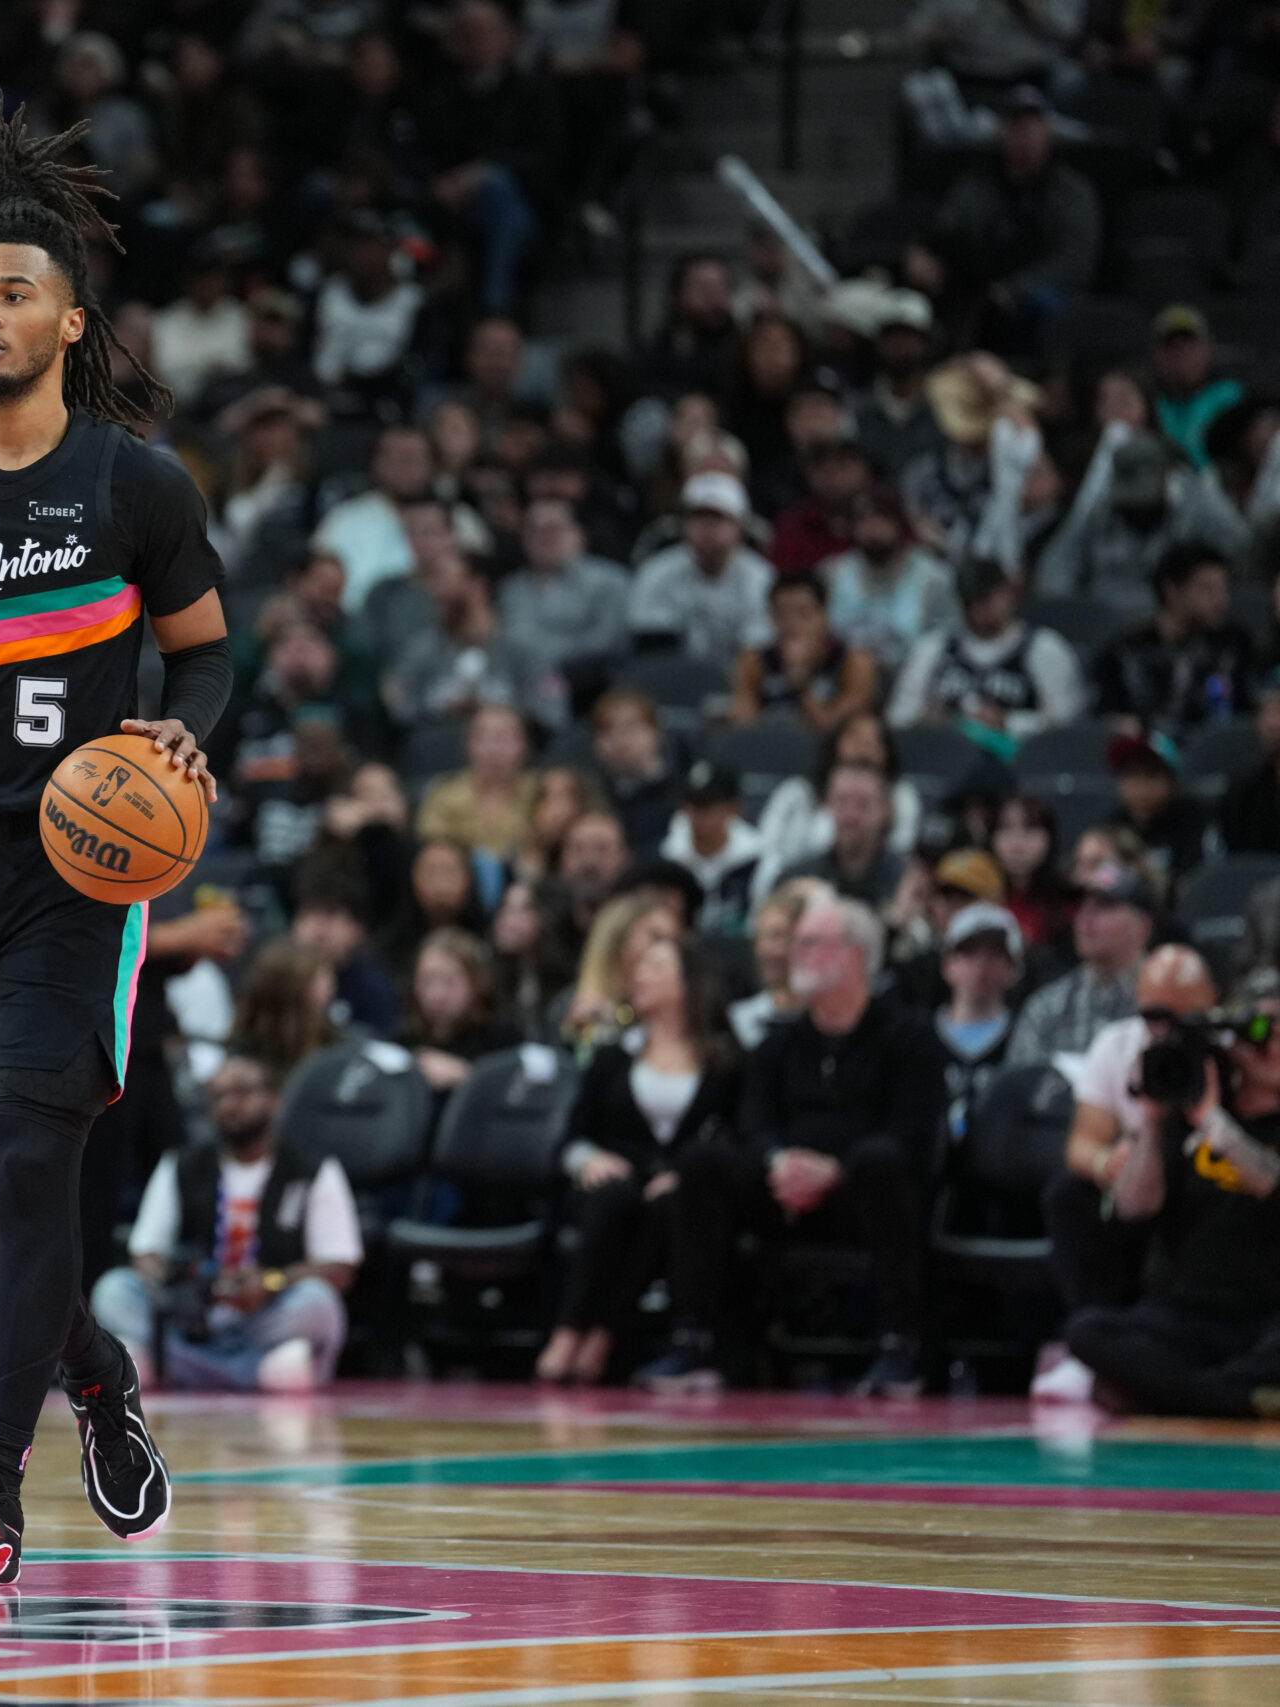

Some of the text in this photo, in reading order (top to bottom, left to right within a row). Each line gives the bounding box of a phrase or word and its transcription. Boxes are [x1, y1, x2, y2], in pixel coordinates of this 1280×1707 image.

[35, 506, 76, 517] LEDGER
[13, 675, 67, 747] 5
[45, 796, 131, 875] Wilson
